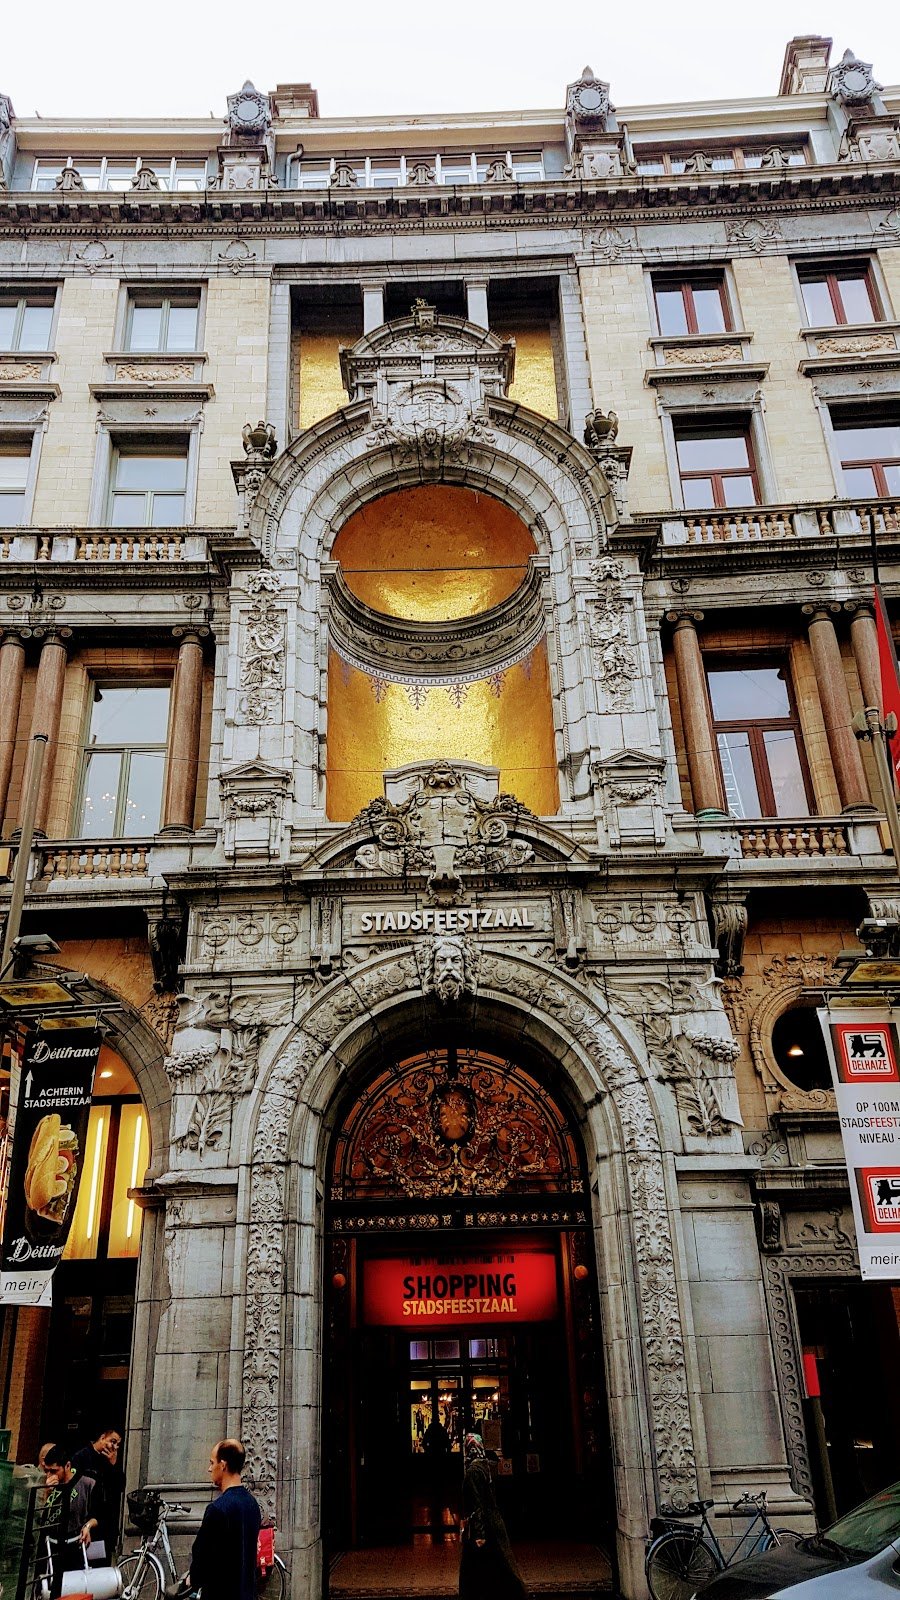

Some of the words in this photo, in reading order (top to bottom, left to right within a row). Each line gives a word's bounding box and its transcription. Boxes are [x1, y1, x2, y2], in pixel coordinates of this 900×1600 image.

[360, 907, 535, 932] STADSFEESTZAAL
[851, 1059, 888, 1071] DELHAIZE
[39, 1086, 84, 1097] ACHTERIN
[856, 1102, 869, 1112] OP
[841, 1117, 900, 1128] STADSFEEST
[859, 1132, 895, 1143] NIVEAU
[403, 1274, 516, 1299] SHOPPING
[402, 1298, 518, 1316] STADSFEESTZAAL
